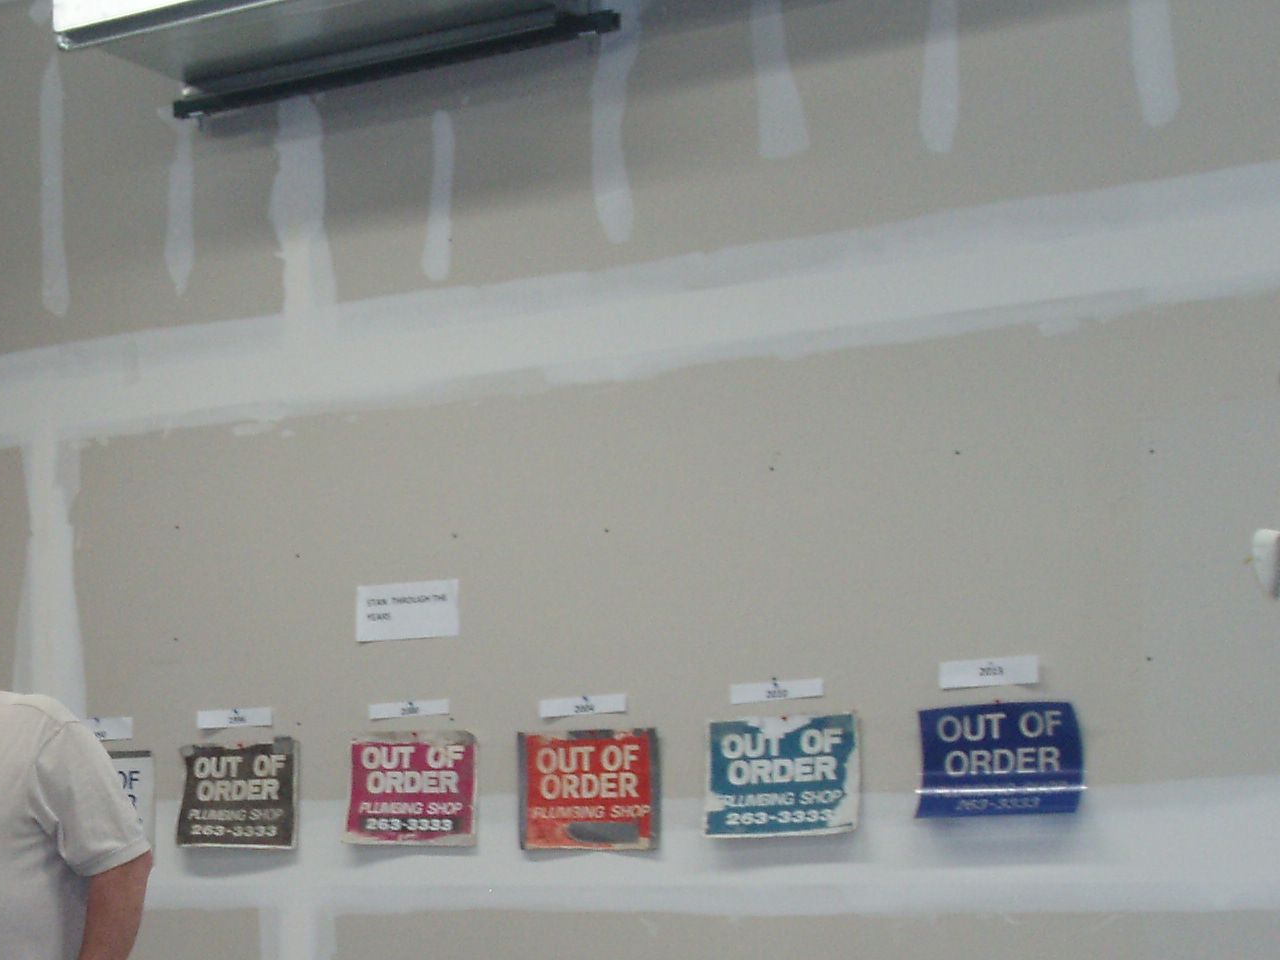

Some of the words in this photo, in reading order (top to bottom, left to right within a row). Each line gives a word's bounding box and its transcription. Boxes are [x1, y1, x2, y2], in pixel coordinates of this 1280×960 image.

[937, 712, 1007, 743] OUT
[1020, 710, 1062, 738] OF
[721, 732, 780, 759] OUT
[800, 728, 843, 755] OF
[193, 755, 243, 779] OUT
[253, 753, 287, 778] OF
[361, 745, 416, 770] OUT
[426, 744, 466, 769] OF
[535, 746, 595, 774] OUT
[600, 744, 640, 772] OF
[727, 755, 837, 785] ORDER
[944, 746, 1061, 777] ORDER
[196, 778, 281, 802] ORDER
[366, 770, 460, 794] ORDER
[540, 772, 640, 800] ORDER
[359, 802, 424, 815] PLUMBING
[426, 802, 463, 815] SHOP
[532, 805, 605, 819] PLUMBING
[610, 804, 651, 818] SHOP
[725, 809, 833, 825] 263-3333
[190, 824, 278, 838] 263-3333
[365, 818, 454, 831] 263-3333
